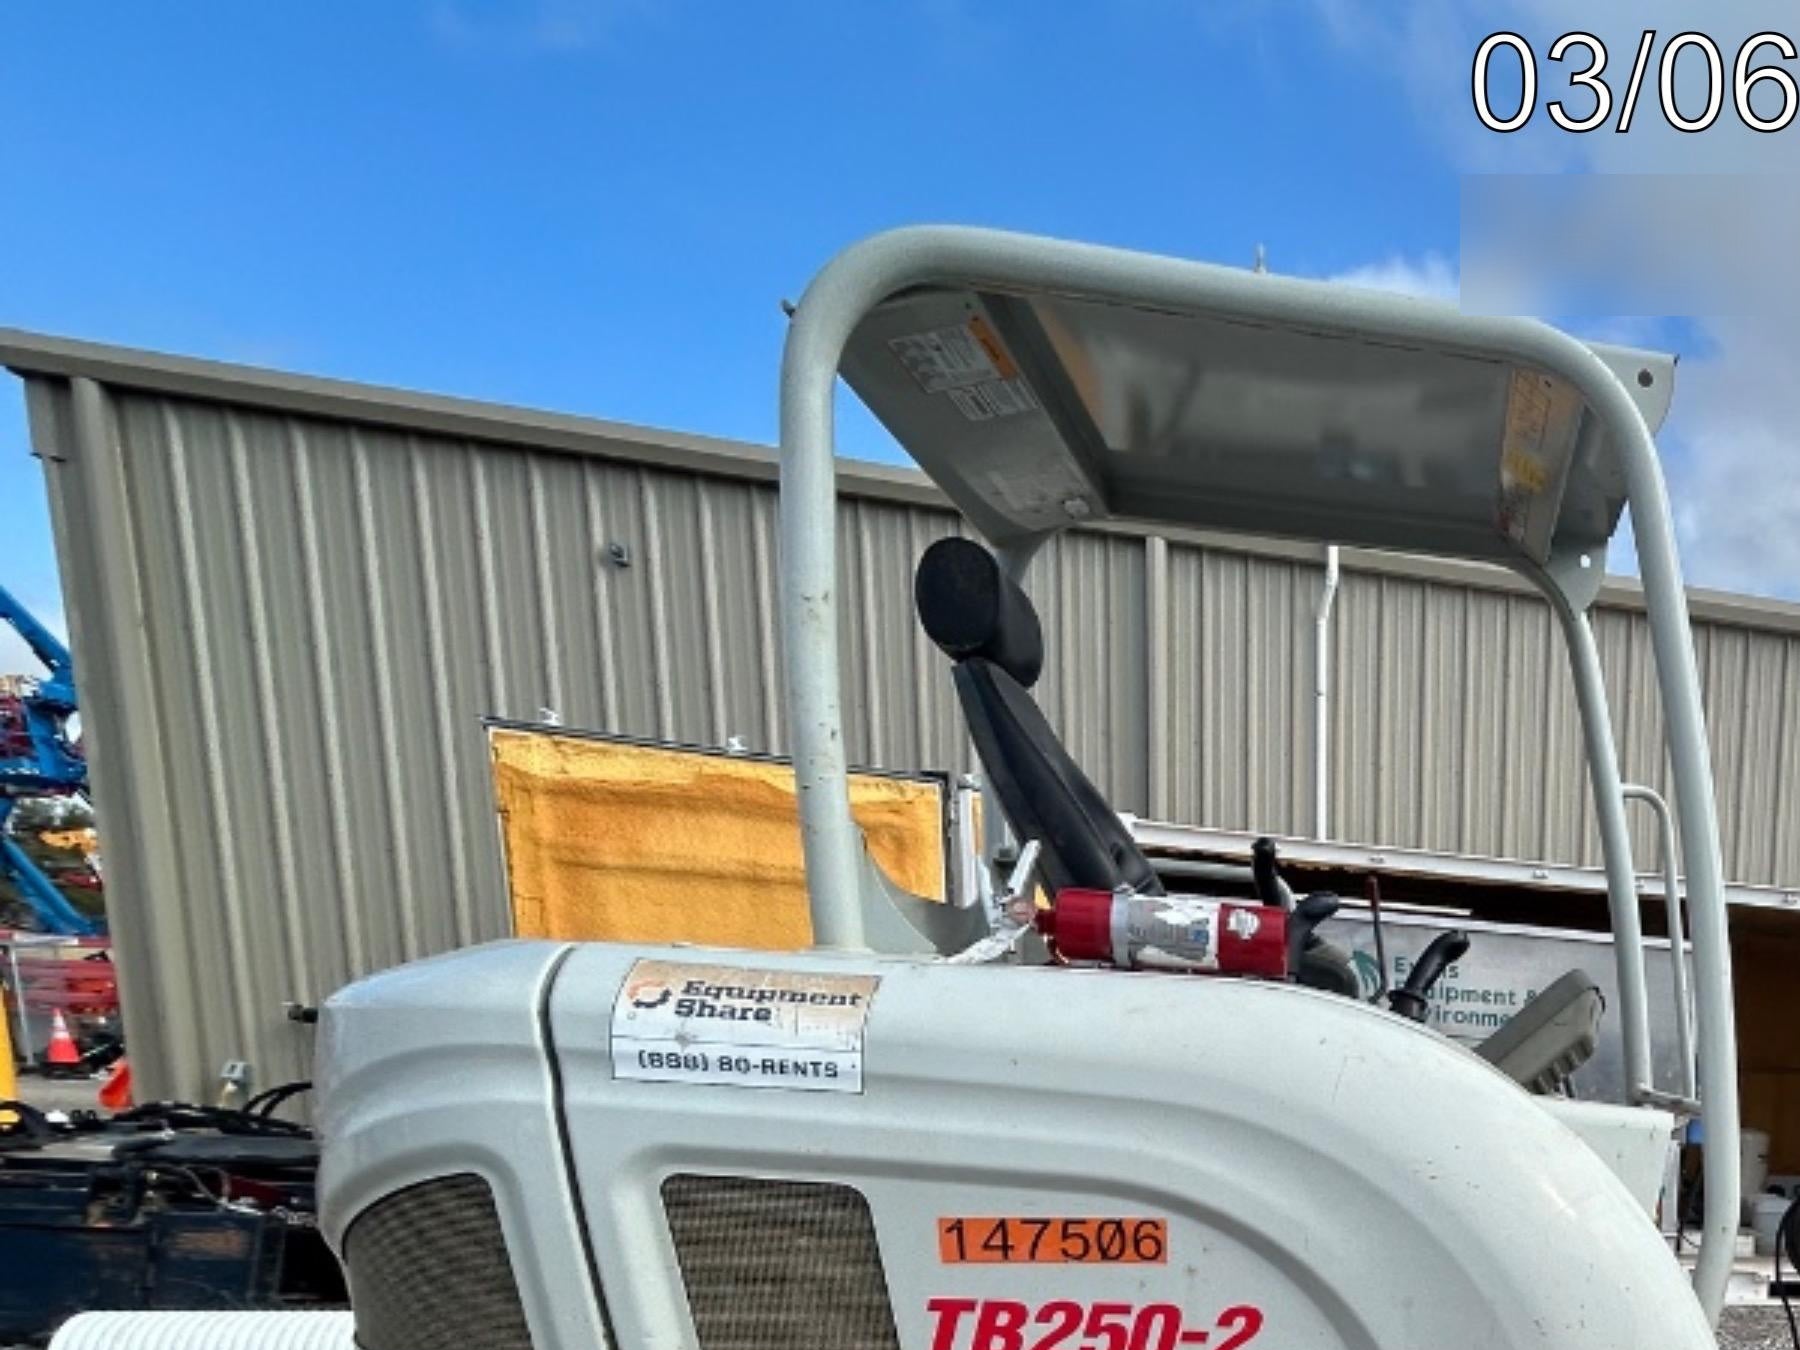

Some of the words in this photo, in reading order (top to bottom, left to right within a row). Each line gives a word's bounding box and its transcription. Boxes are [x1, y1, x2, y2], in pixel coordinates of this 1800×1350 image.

[681, 980, 861, 1007] Equipment
[1394, 979, 1516, 1005] Euipment
[674, 998, 772, 1022] Share
[718, 1055, 839, 1078] 80-RENTS
[945, 1218, 1162, 1261] 147506
